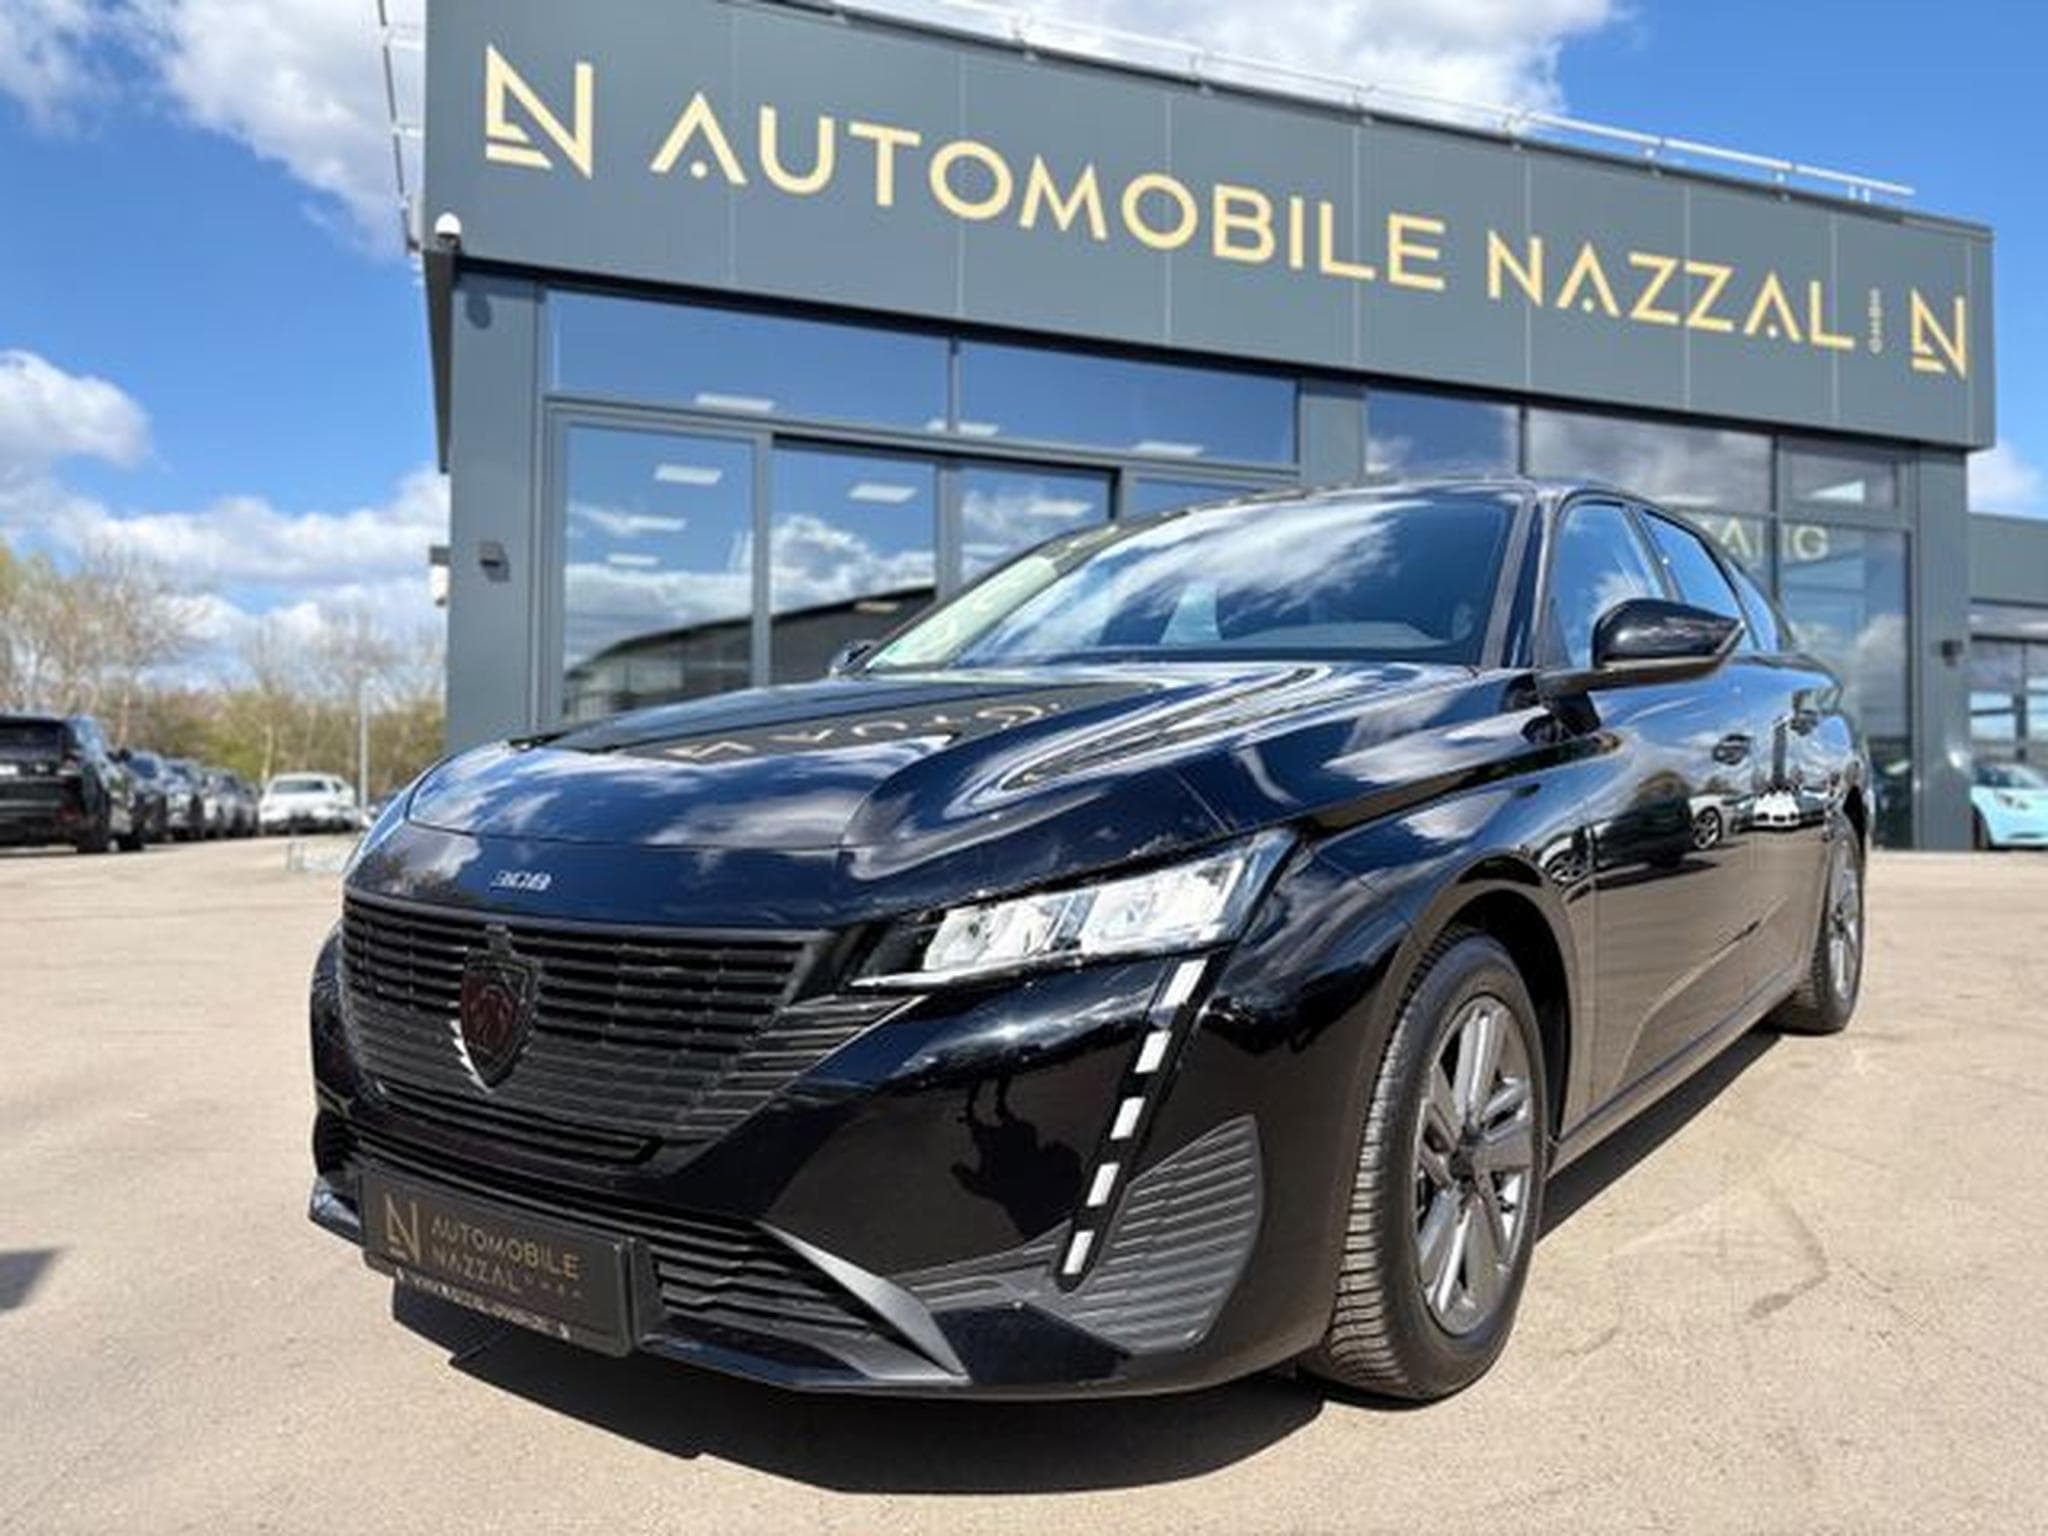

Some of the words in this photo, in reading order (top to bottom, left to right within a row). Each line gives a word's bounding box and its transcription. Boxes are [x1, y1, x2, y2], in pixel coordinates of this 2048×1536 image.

[650, 92, 1446, 291] AUTOMOBILE
[1487, 229, 1855, 350] NAZZAL
[431, 1215, 581, 1281] AUTOMOBILE
